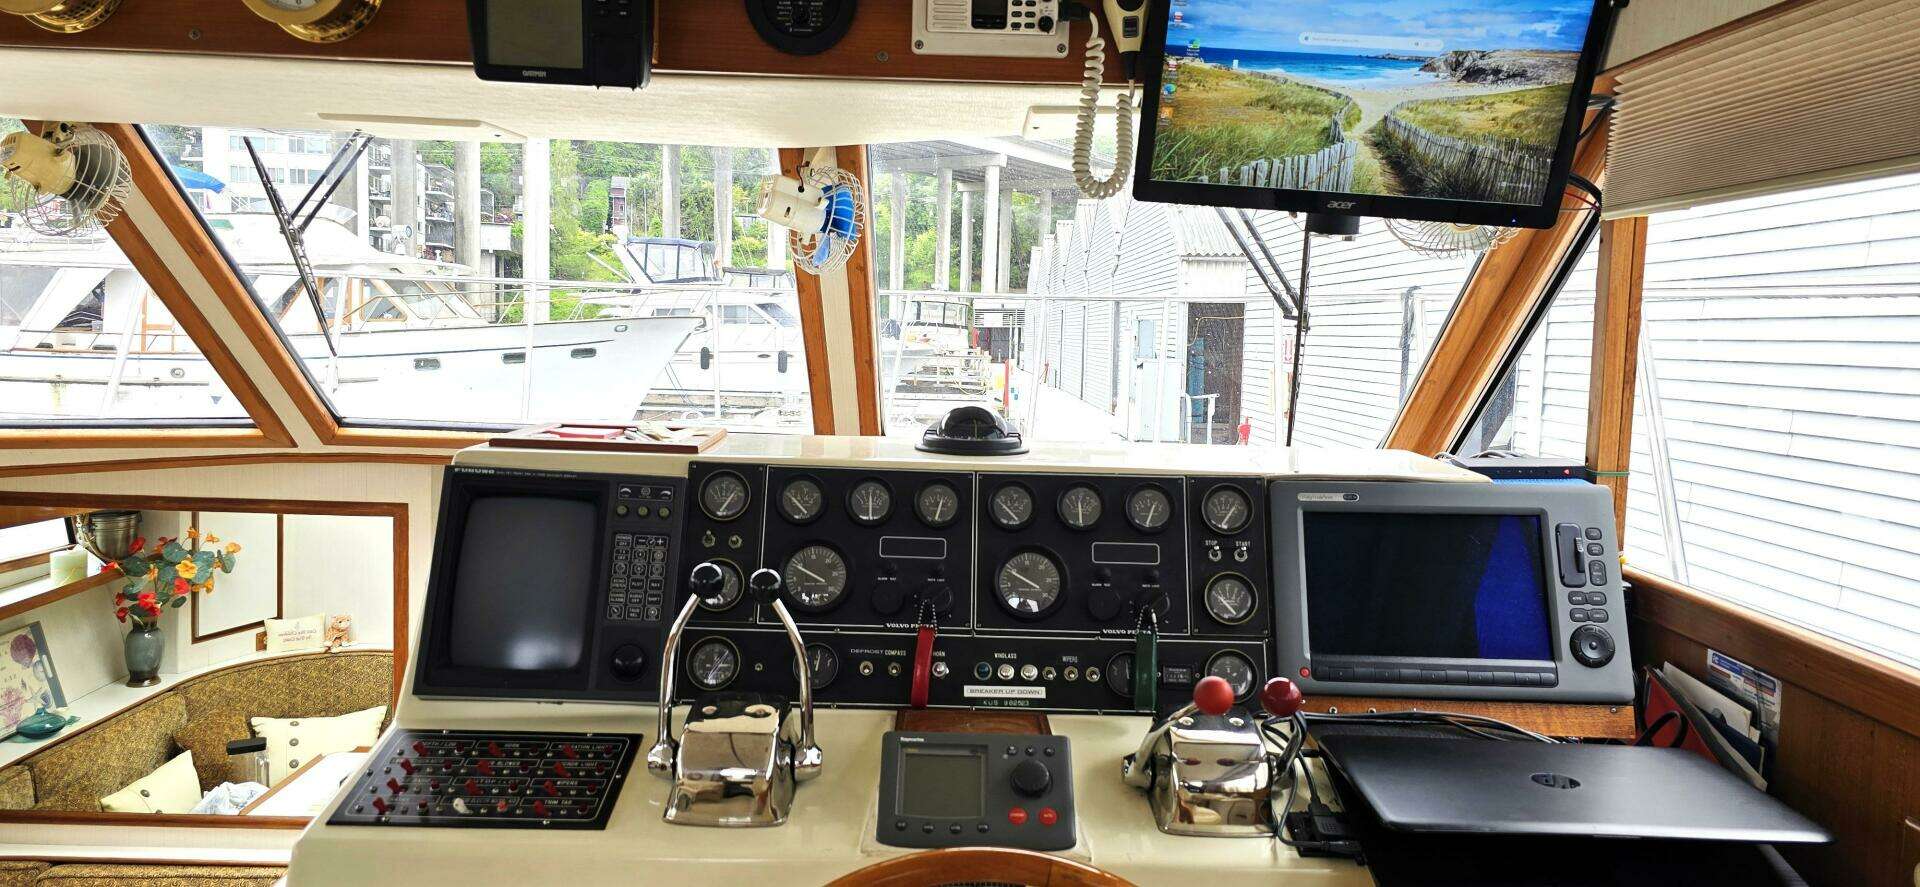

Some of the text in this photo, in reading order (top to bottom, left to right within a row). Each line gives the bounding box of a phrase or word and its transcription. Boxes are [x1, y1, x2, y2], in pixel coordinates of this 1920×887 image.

[1327, 200, 1357, 210] acer
[454, 467, 495, 475] FURUNO
[884, 649, 907, 657] COMPASS
[969, 687, 1004, 695] BREAKER
[1017, 688, 1041, 696] DOWN
